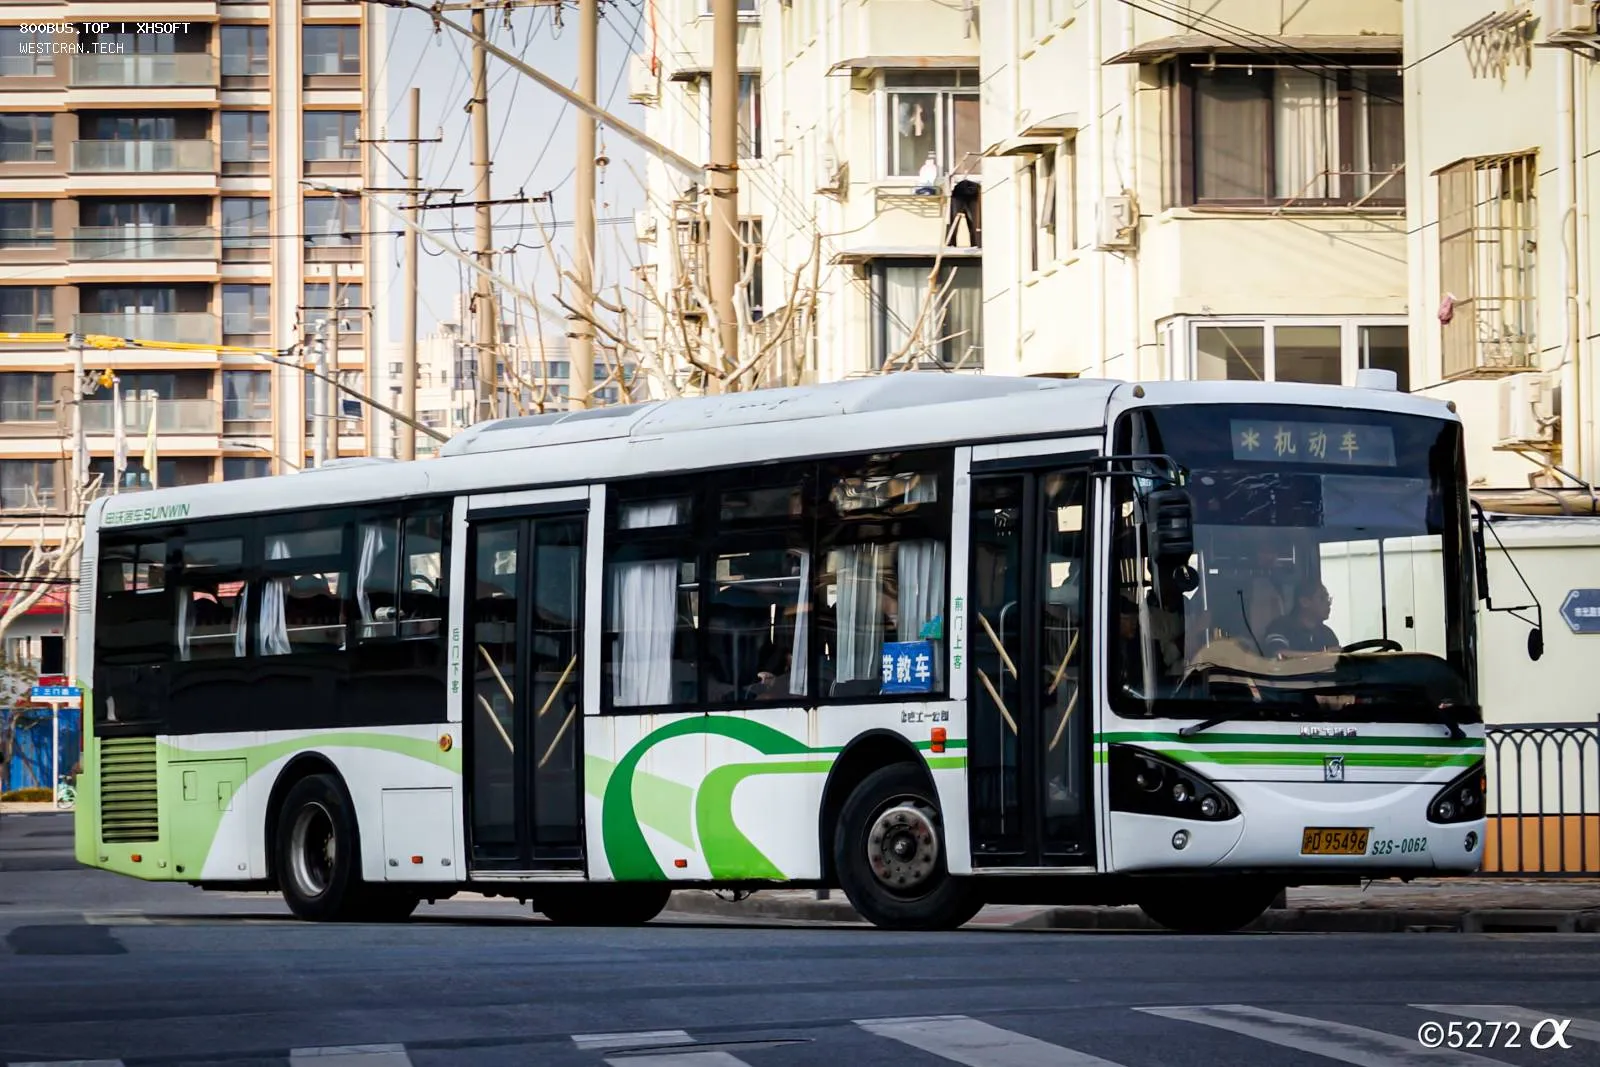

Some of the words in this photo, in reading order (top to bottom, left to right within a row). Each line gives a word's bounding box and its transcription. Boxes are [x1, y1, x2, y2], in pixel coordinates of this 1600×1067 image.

[881, 652, 931, 684] 带教车
[1372, 837, 1428, 856] S2S-0062
